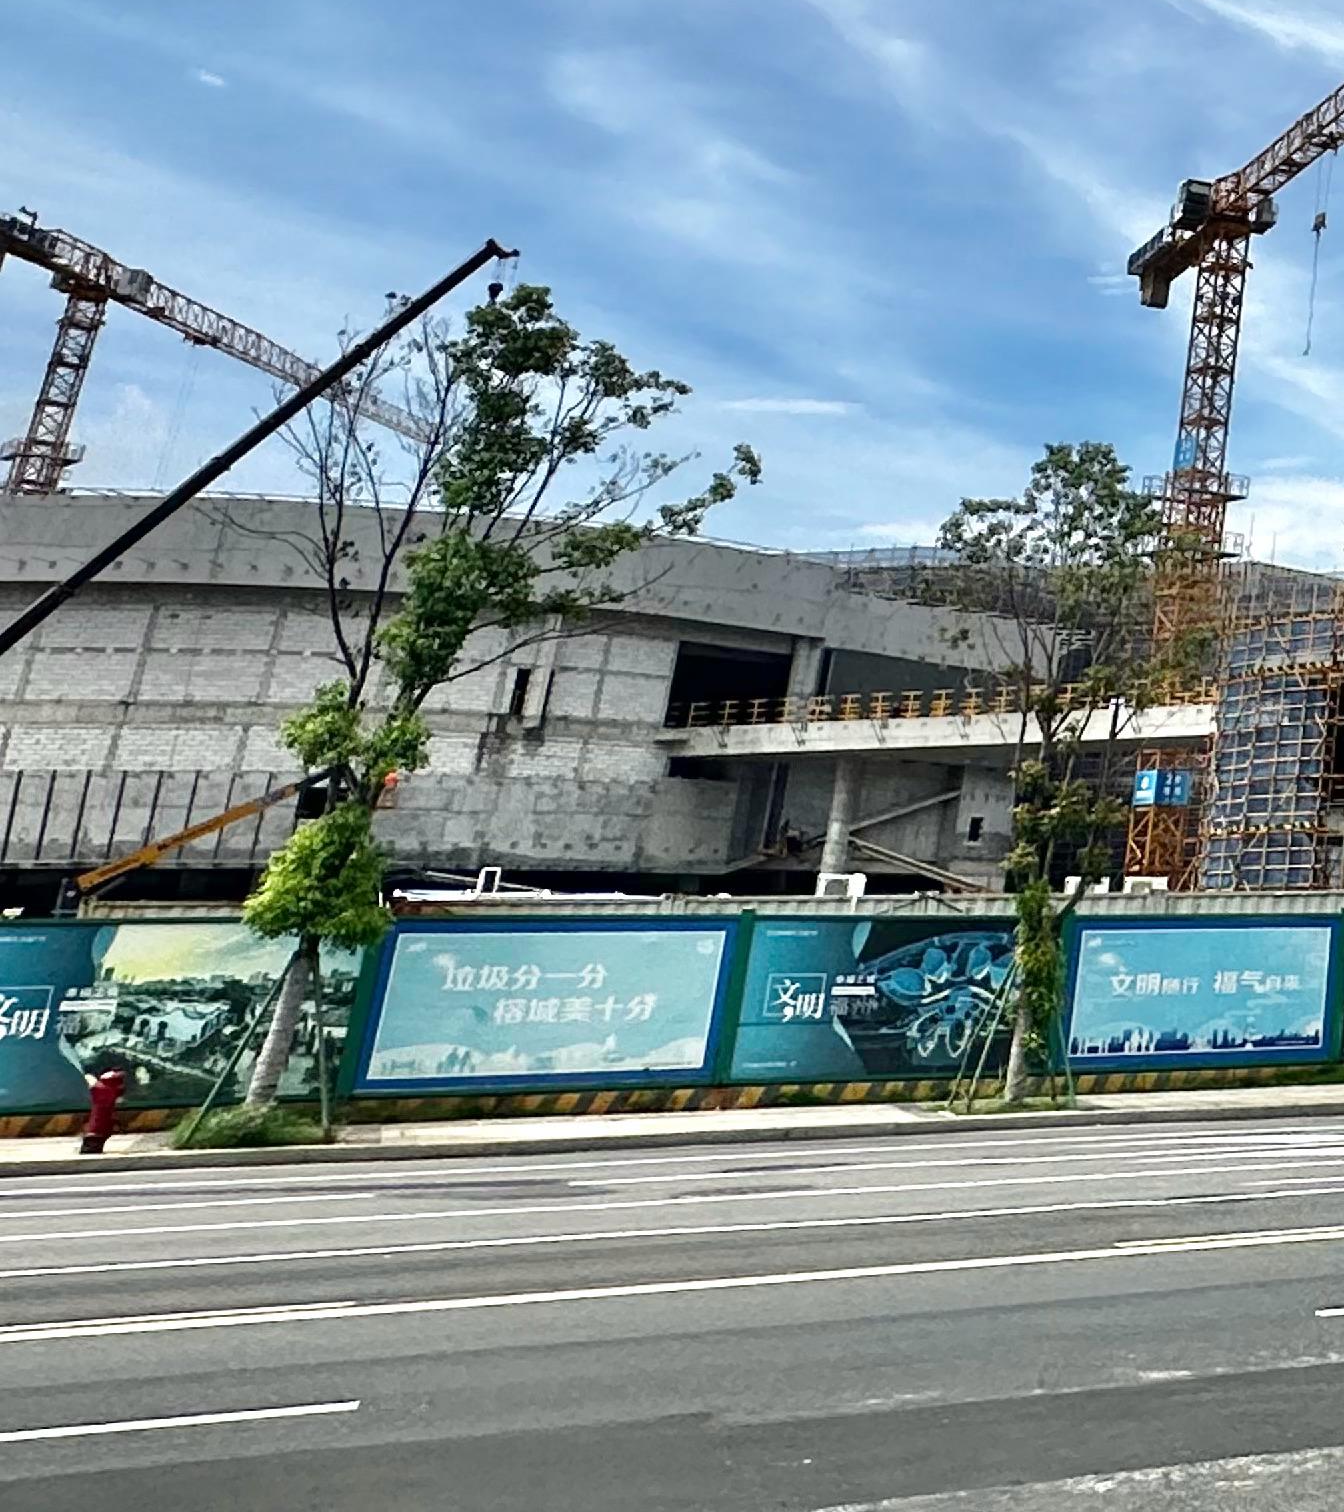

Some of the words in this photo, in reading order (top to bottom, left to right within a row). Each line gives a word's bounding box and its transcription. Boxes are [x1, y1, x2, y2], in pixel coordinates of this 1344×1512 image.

[441, 963, 608, 991] 垃圾分一分
[493, 992, 658, 1024] 榕城美十分
